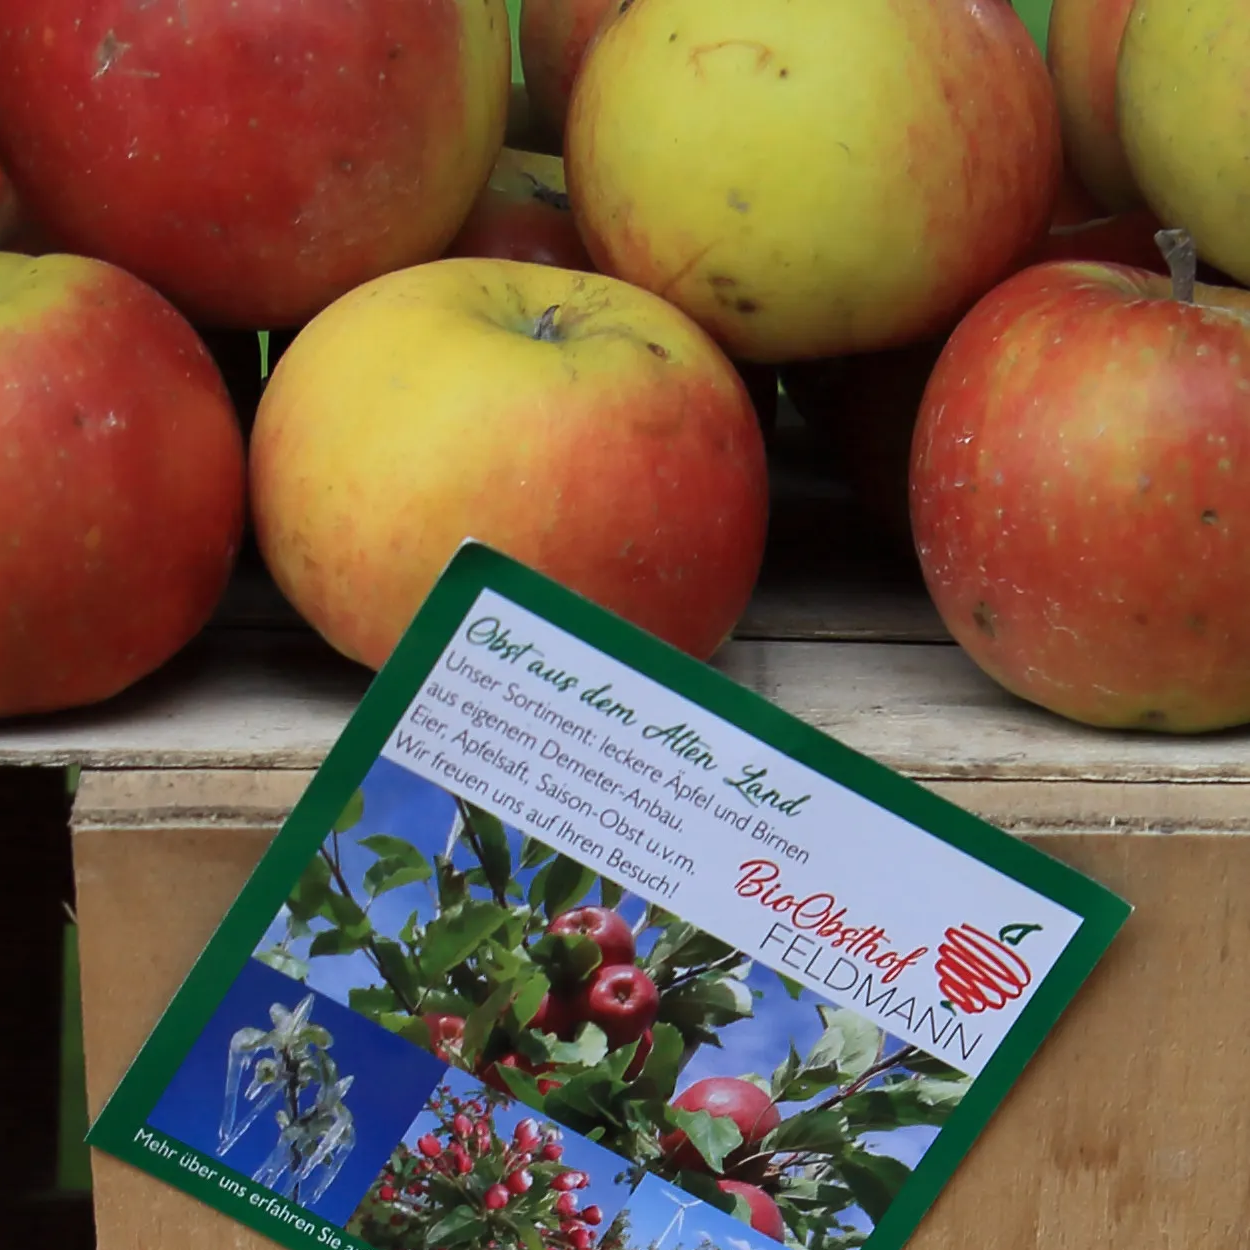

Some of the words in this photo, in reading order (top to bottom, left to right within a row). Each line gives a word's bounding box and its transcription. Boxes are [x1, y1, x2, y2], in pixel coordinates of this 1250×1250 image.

[410, 704, 447, 739] Eier,
[451, 725, 530, 787] Apfelsaft,
[535, 771, 647, 846] Saison-Obst
[646, 839, 695, 876] u.v.m.
[426, 680, 455, 707] aus
[461, 696, 537, 751] eigenem
[541, 737, 684, 834] Demeter-Anbau.
[446, 651, 499, 692] Unser
[506, 682, 594, 747] Sortiment:
[599, 734, 662, 784] leckere
[664, 769, 714, 812] Äpfel
[714, 799, 751, 832] und
[751, 820, 809, 866] Birnen
[466, 616, 535, 664] Obst
[527, 658, 577, 693] aus
[581, 684, 636, 727] dem
[642, 722, 718, 773] Alten
[724, 763, 812, 819] Land
[395, 731, 430, 764] Wir
[431, 751, 489, 796] freuen
[492, 786, 524, 815] uns
[526, 801, 557, 833] auf
[556, 820, 603, 858] Ihren
[605, 848, 680, 899] Besuch!
[734, 860, 928, 984] BioObsthof
[760, 922, 982, 1060] FELDMANN
[134, 1128, 178, 1160] Mehr
[179, 1153, 218, 1181] über
[219, 1177, 247, 1198] uns
[250, 1193, 316, 1235] erfahren
[317, 1227, 341, 1250] Sie
